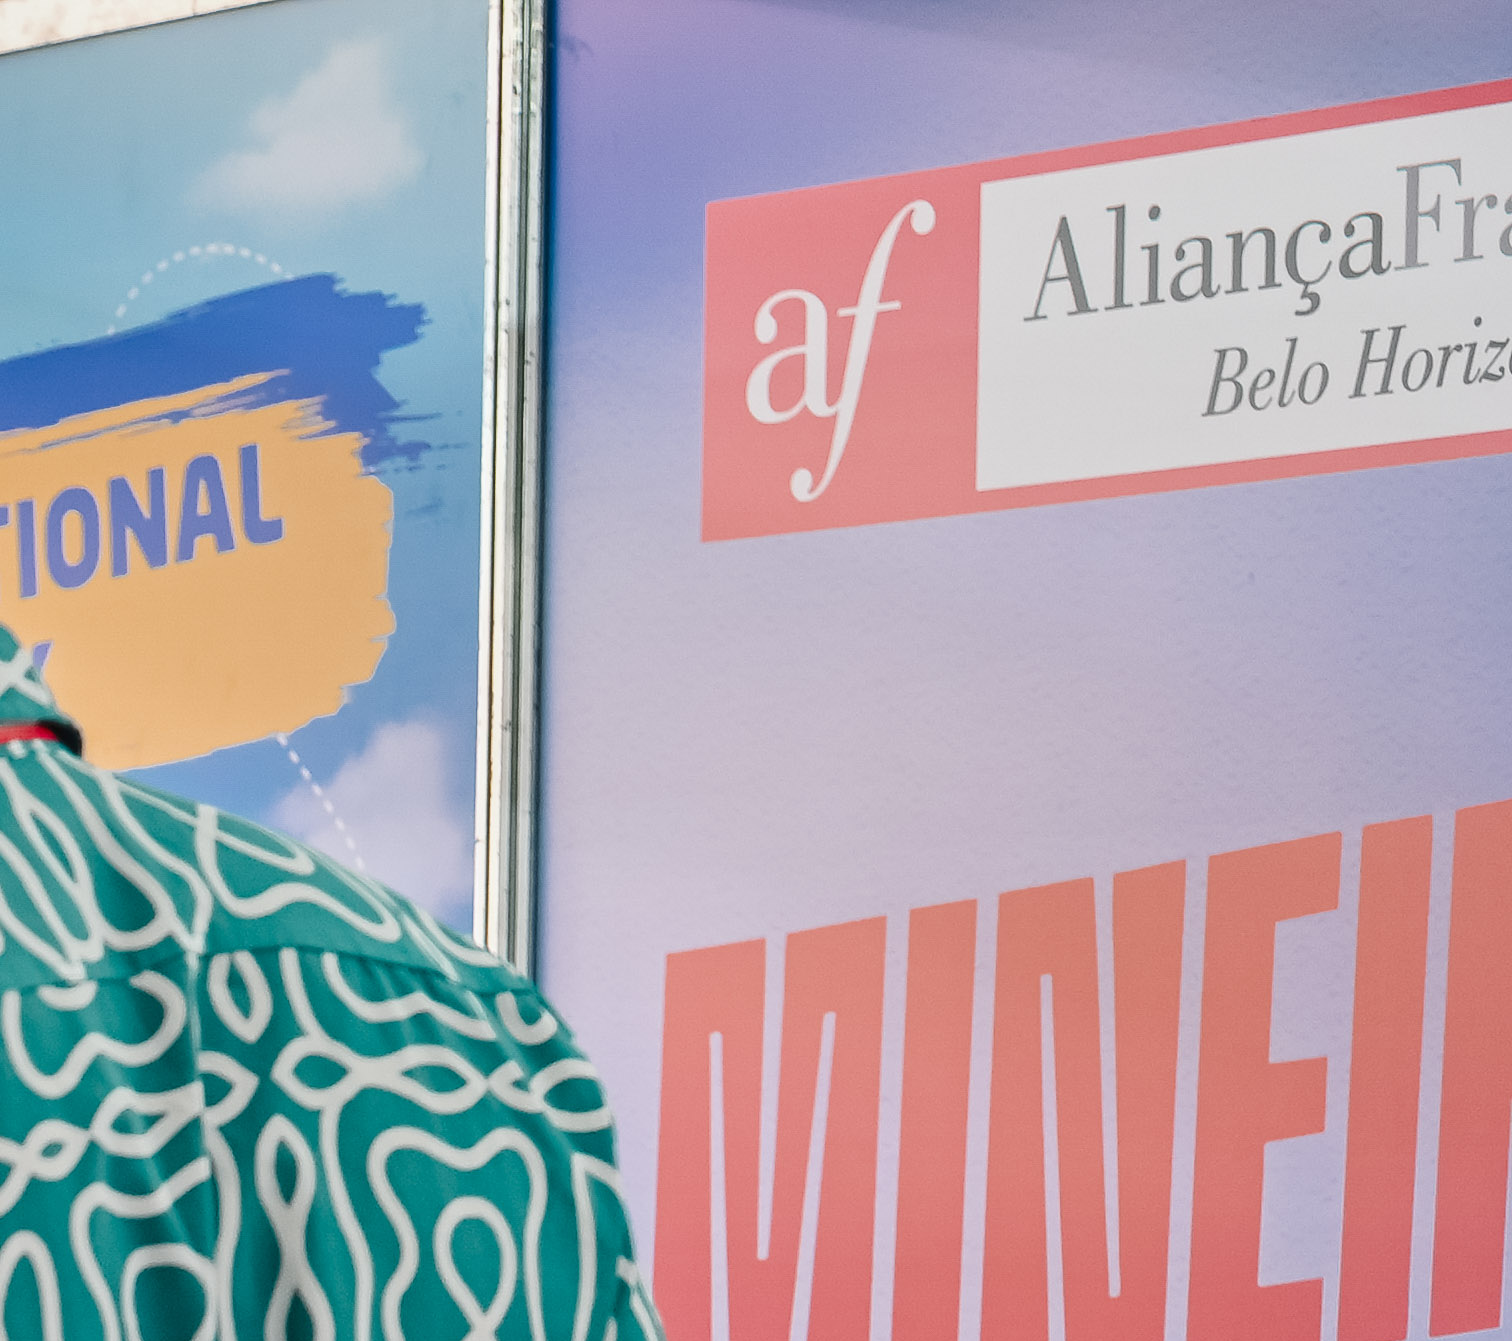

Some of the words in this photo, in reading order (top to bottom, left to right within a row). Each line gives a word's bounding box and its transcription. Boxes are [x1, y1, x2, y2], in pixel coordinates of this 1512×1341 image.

[744, 199, 936, 503] af
[1201, 337, 1330, 418] Belo
[1349, 316, 1512, 400] Horiz
